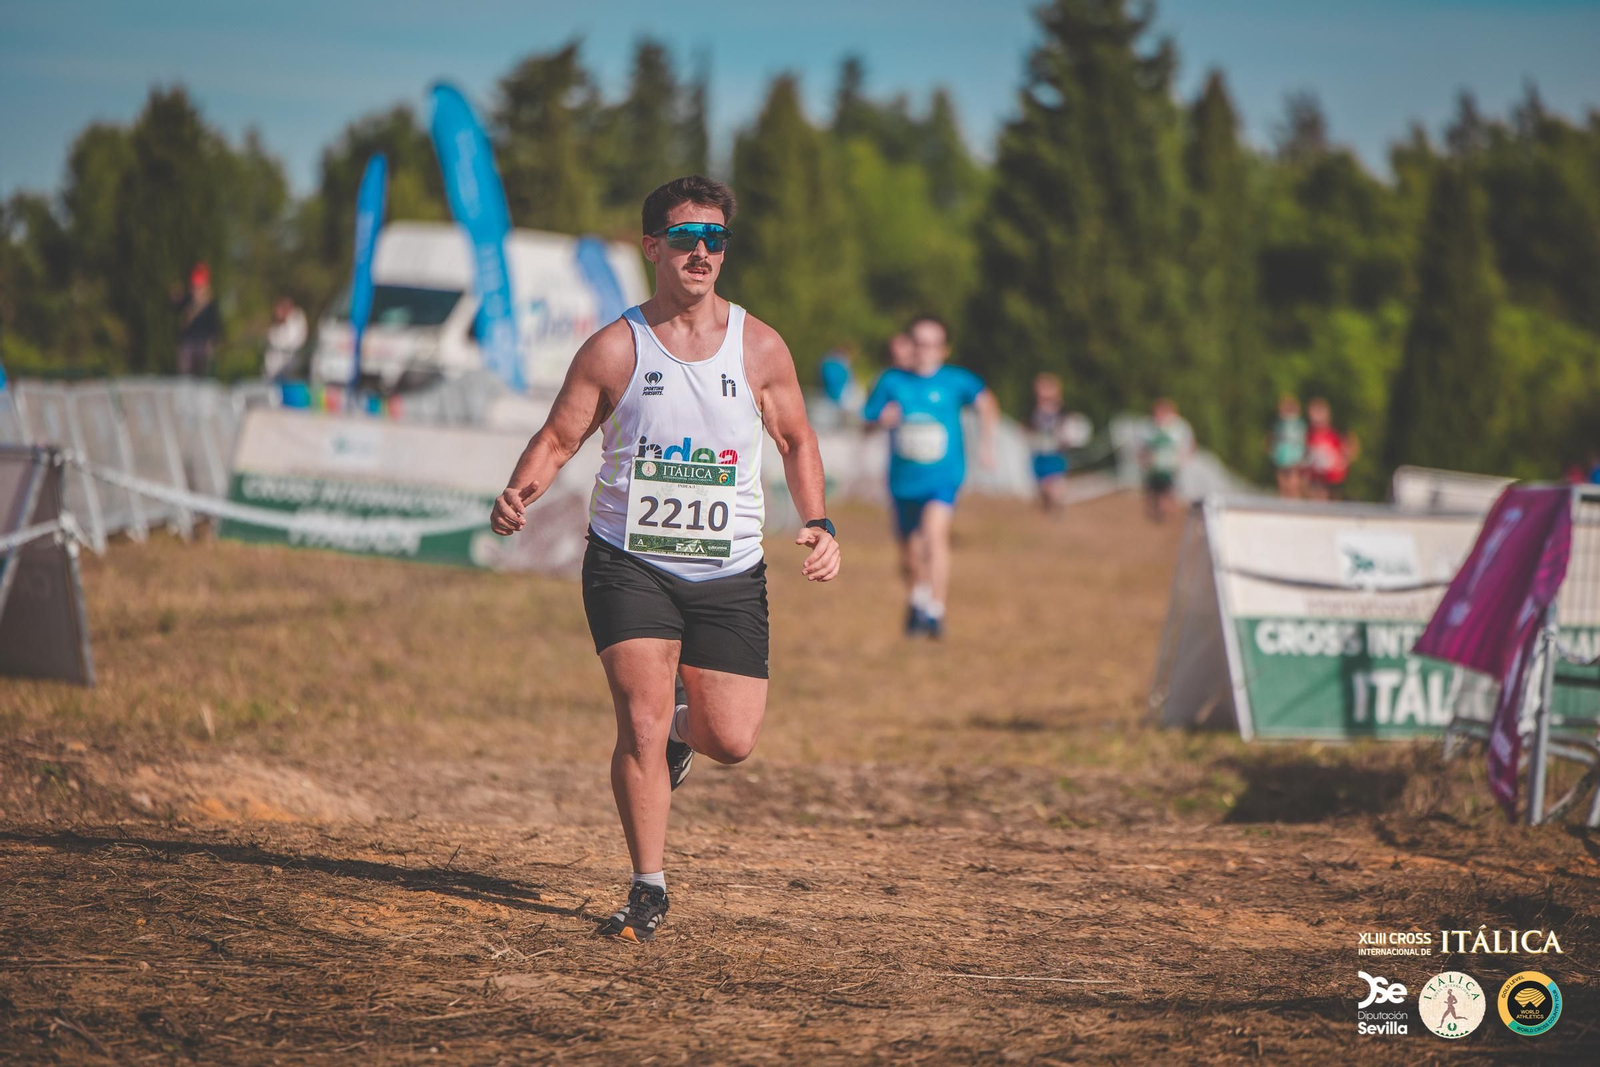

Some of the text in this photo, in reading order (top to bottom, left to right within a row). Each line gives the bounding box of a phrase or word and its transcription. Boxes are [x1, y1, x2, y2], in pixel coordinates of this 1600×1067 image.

[663, 464, 713, 479] ITÁLICA
[638, 495, 729, 532] 2210
[1254, 620, 1362, 656] CROSS
